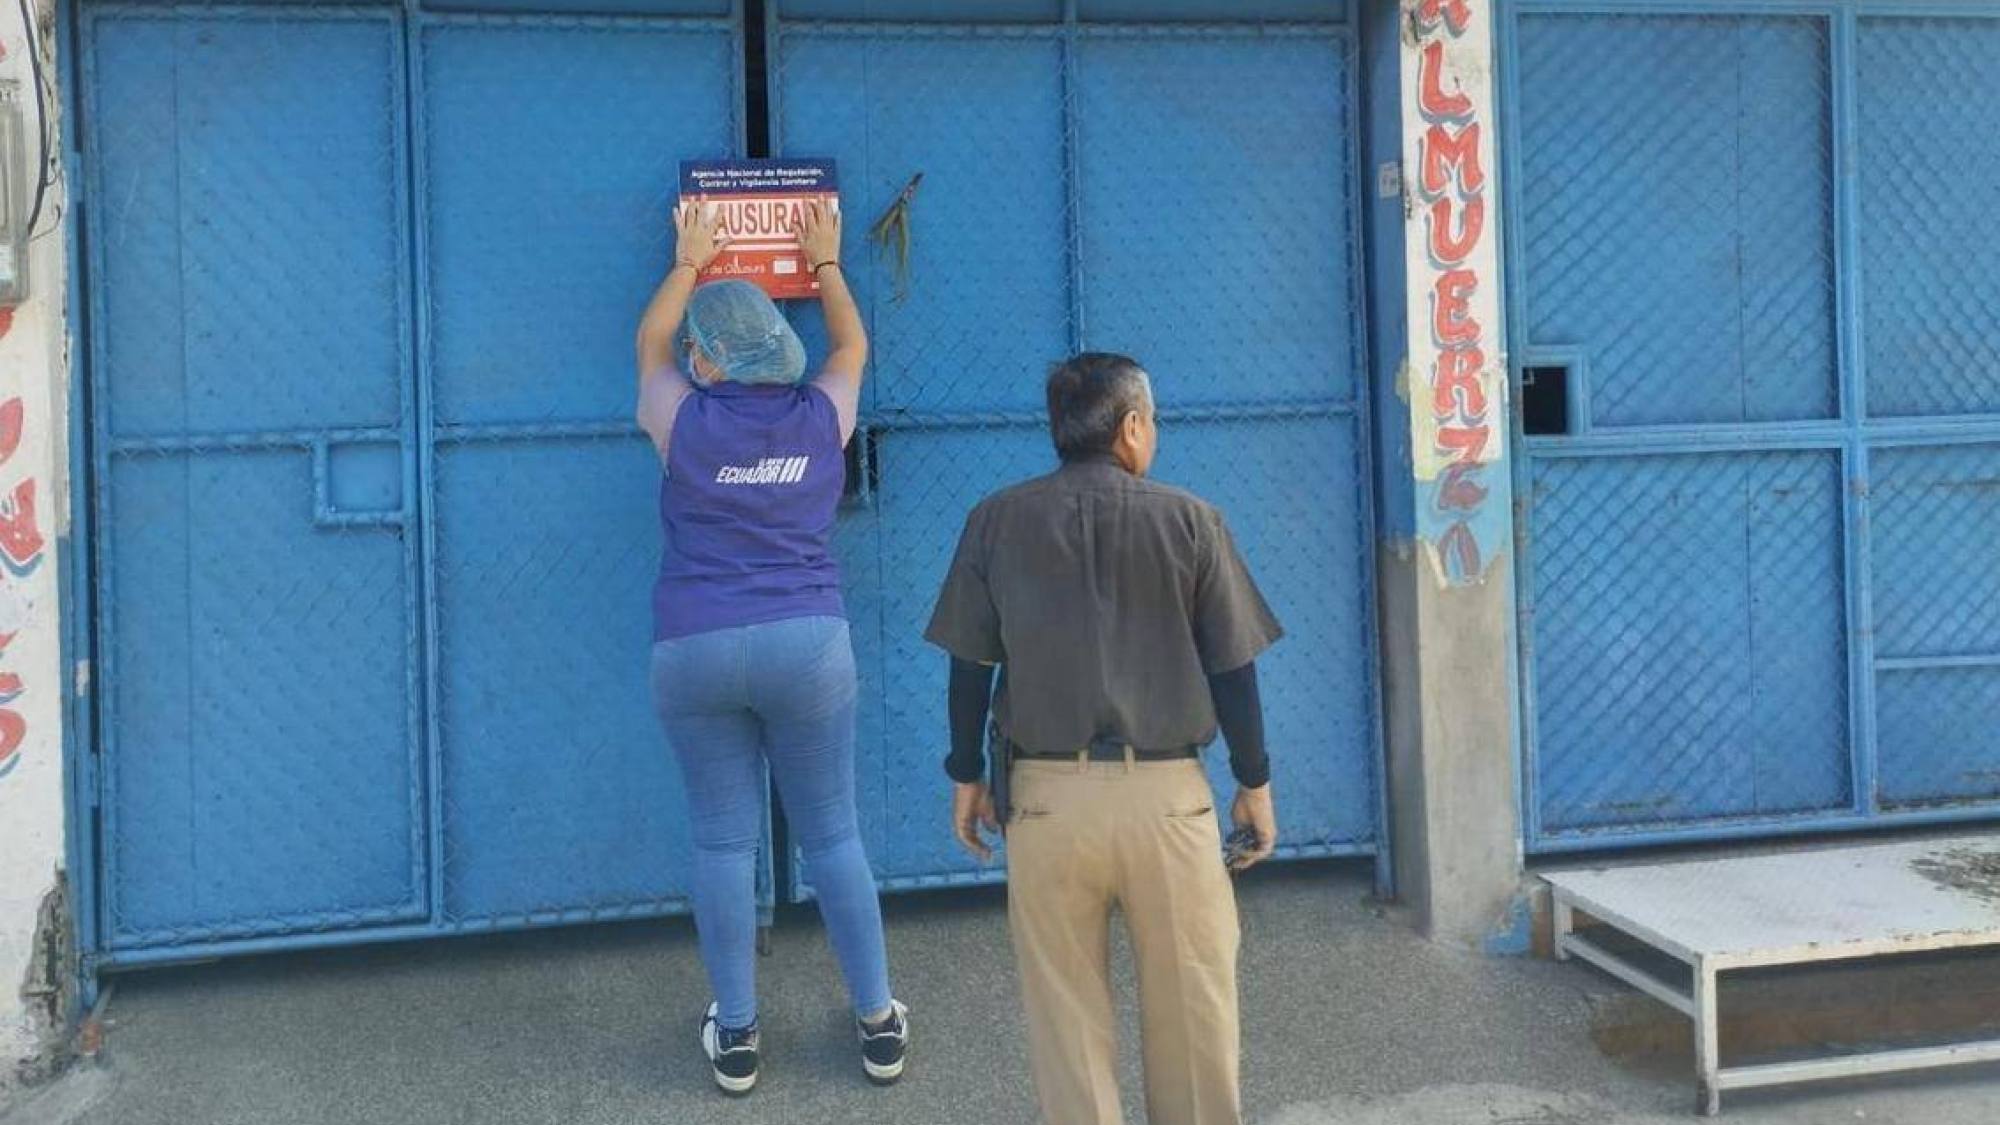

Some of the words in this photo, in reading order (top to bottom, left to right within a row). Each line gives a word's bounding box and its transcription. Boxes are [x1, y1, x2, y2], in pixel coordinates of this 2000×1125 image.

[691, 169, 724, 178] Agencia
[727, 169, 762, 177] Nacional
[764, 168, 775, 177] de
[699, 179, 729, 187] Control
[739, 178, 779, 187] Vigilancia
[715, 466, 781, 484] ECUADOR
